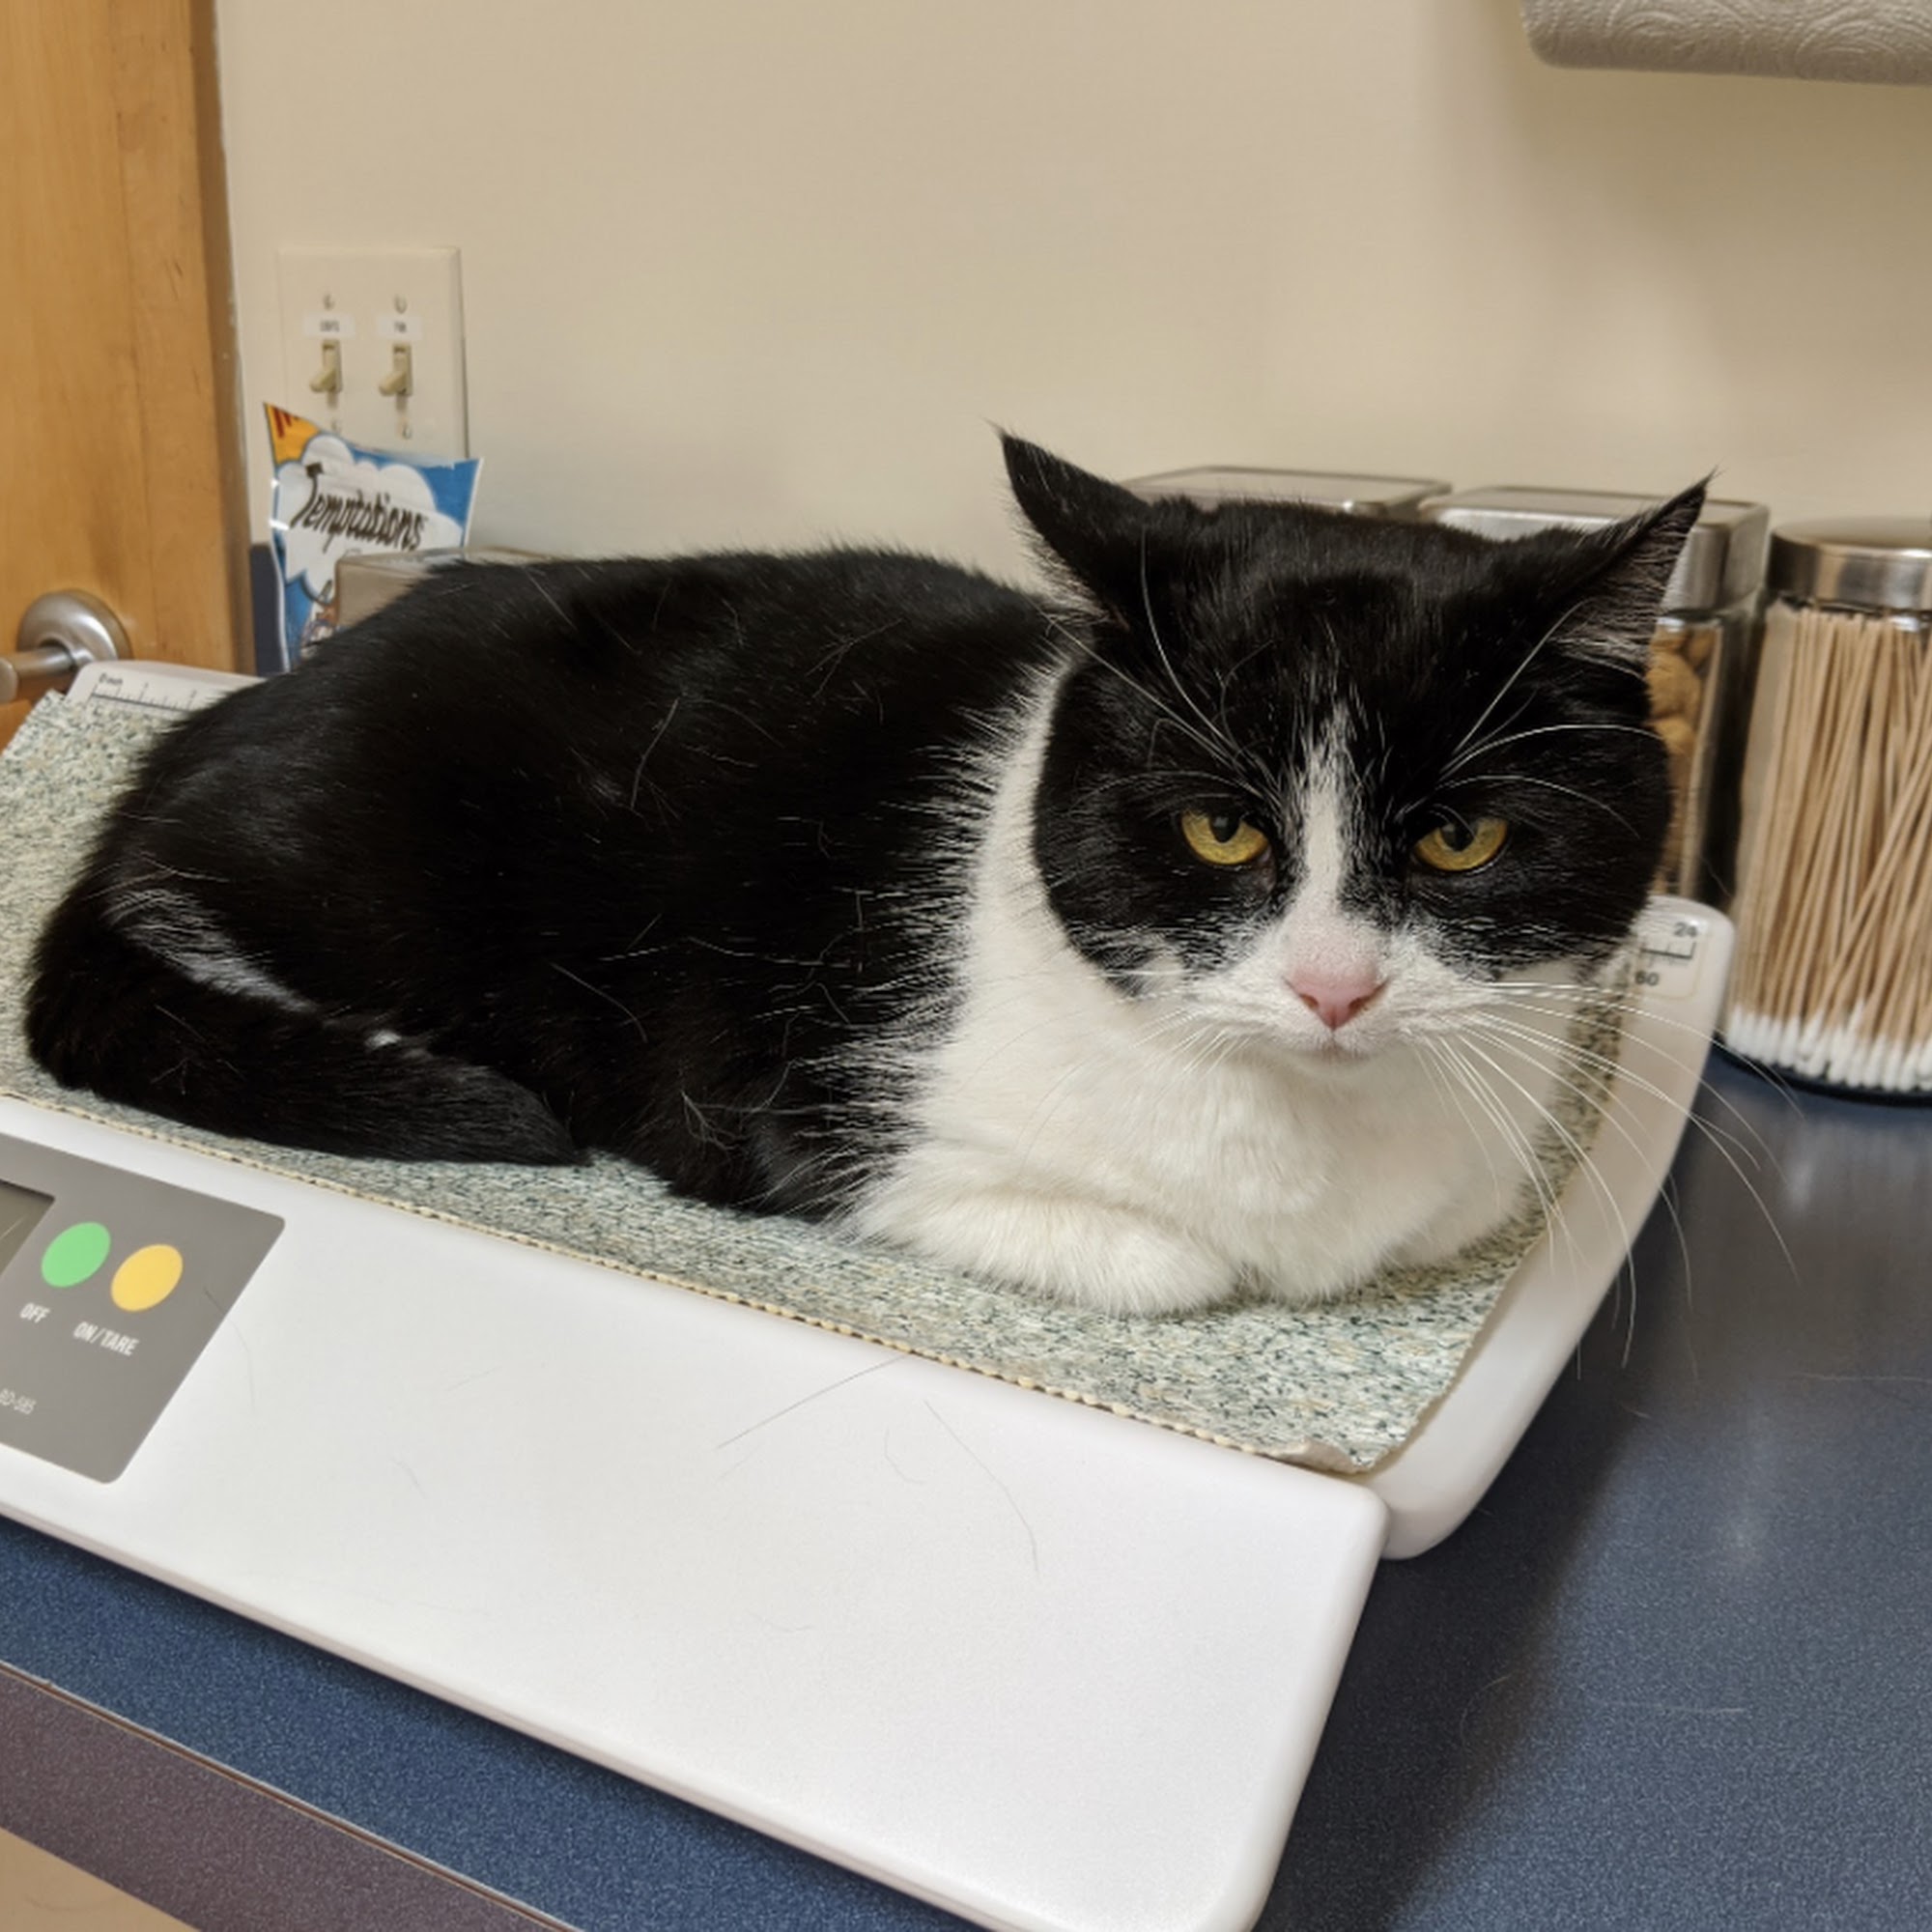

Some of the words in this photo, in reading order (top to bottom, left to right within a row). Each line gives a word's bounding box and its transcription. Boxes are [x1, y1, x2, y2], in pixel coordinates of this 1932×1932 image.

[290, 462, 428, 554] Temptations
[19, 1301, 51, 1324] OFF
[72, 1321, 140, 1357] ON/TARE
